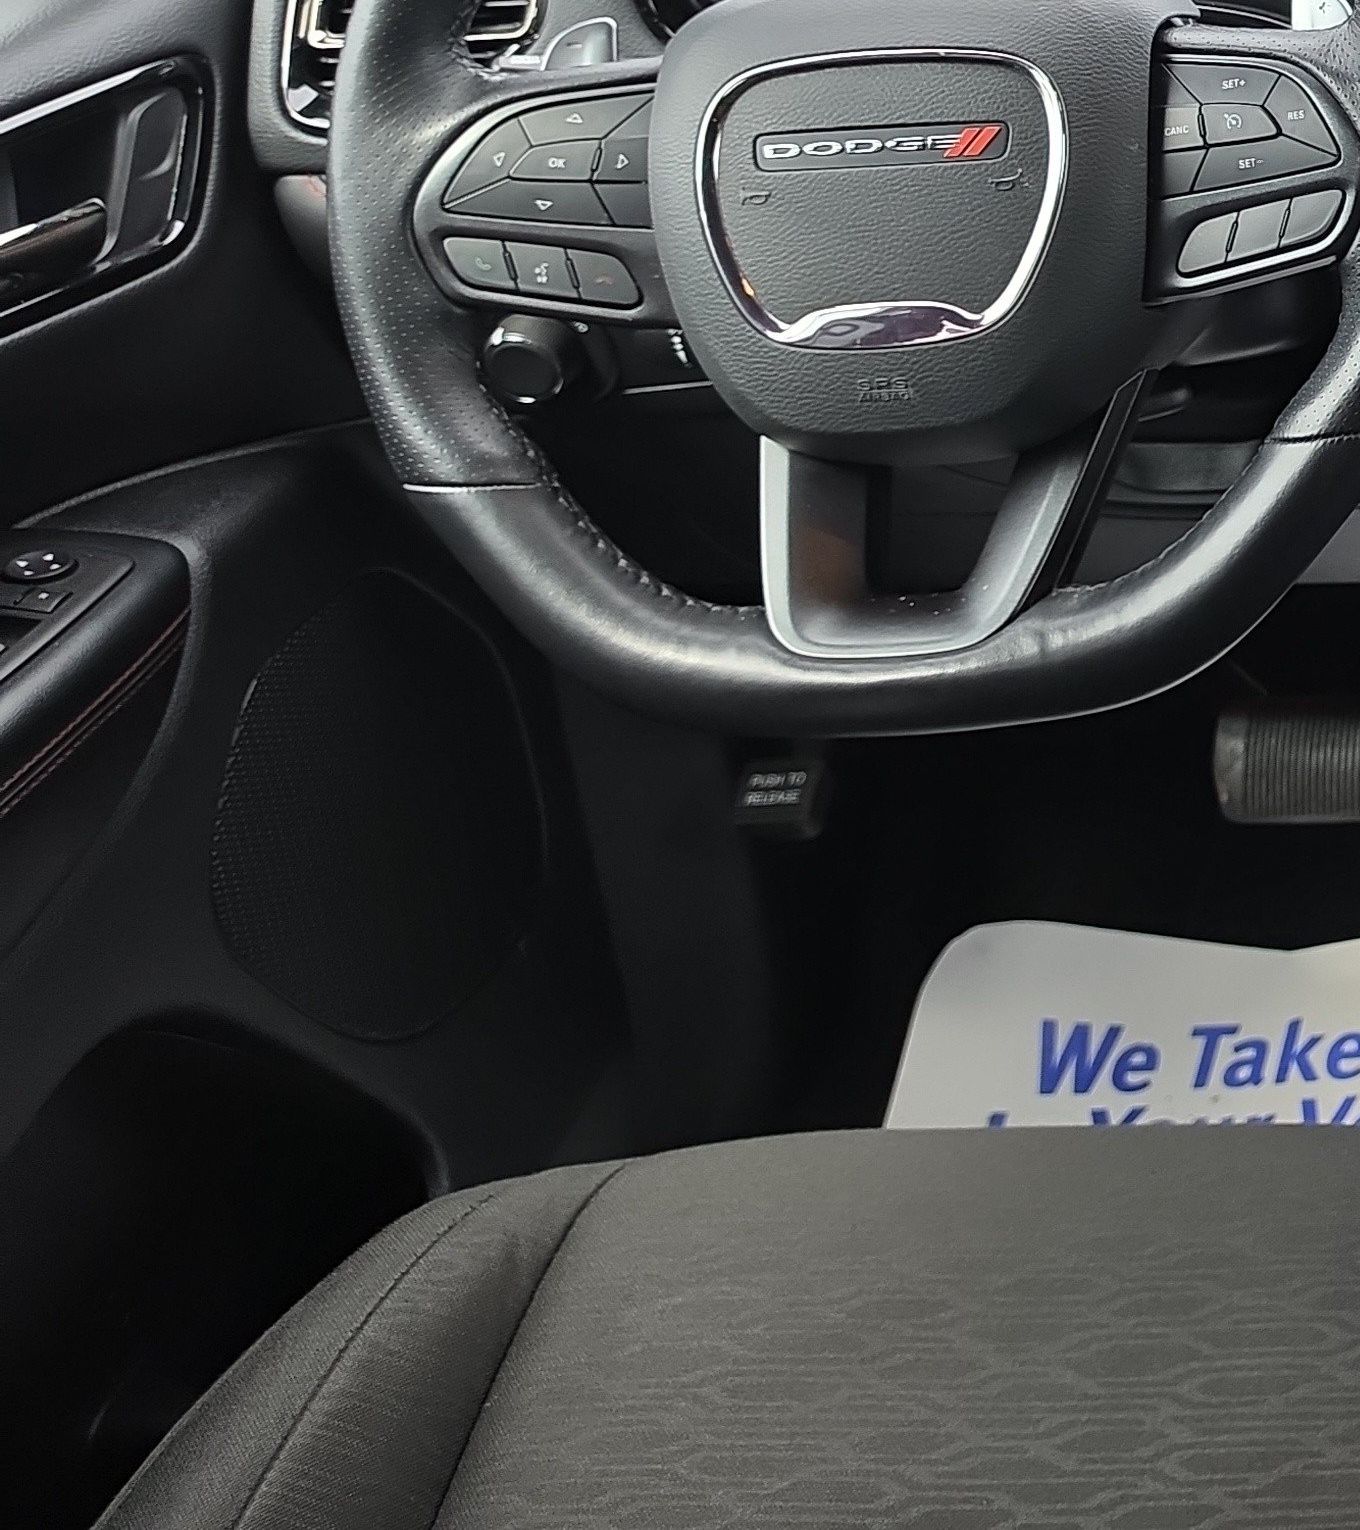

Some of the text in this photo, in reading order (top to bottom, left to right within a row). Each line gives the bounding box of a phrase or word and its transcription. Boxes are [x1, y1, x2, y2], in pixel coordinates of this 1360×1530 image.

[1221, 78, 1247, 91] SET+
[1287, 109, 1306, 121] RES
[1164, 125, 1190, 136] CANC
[761, 133, 962, 160] DODGE
[547, 156, 567, 169] OK
[1039, 1017, 1162, 1096] We
